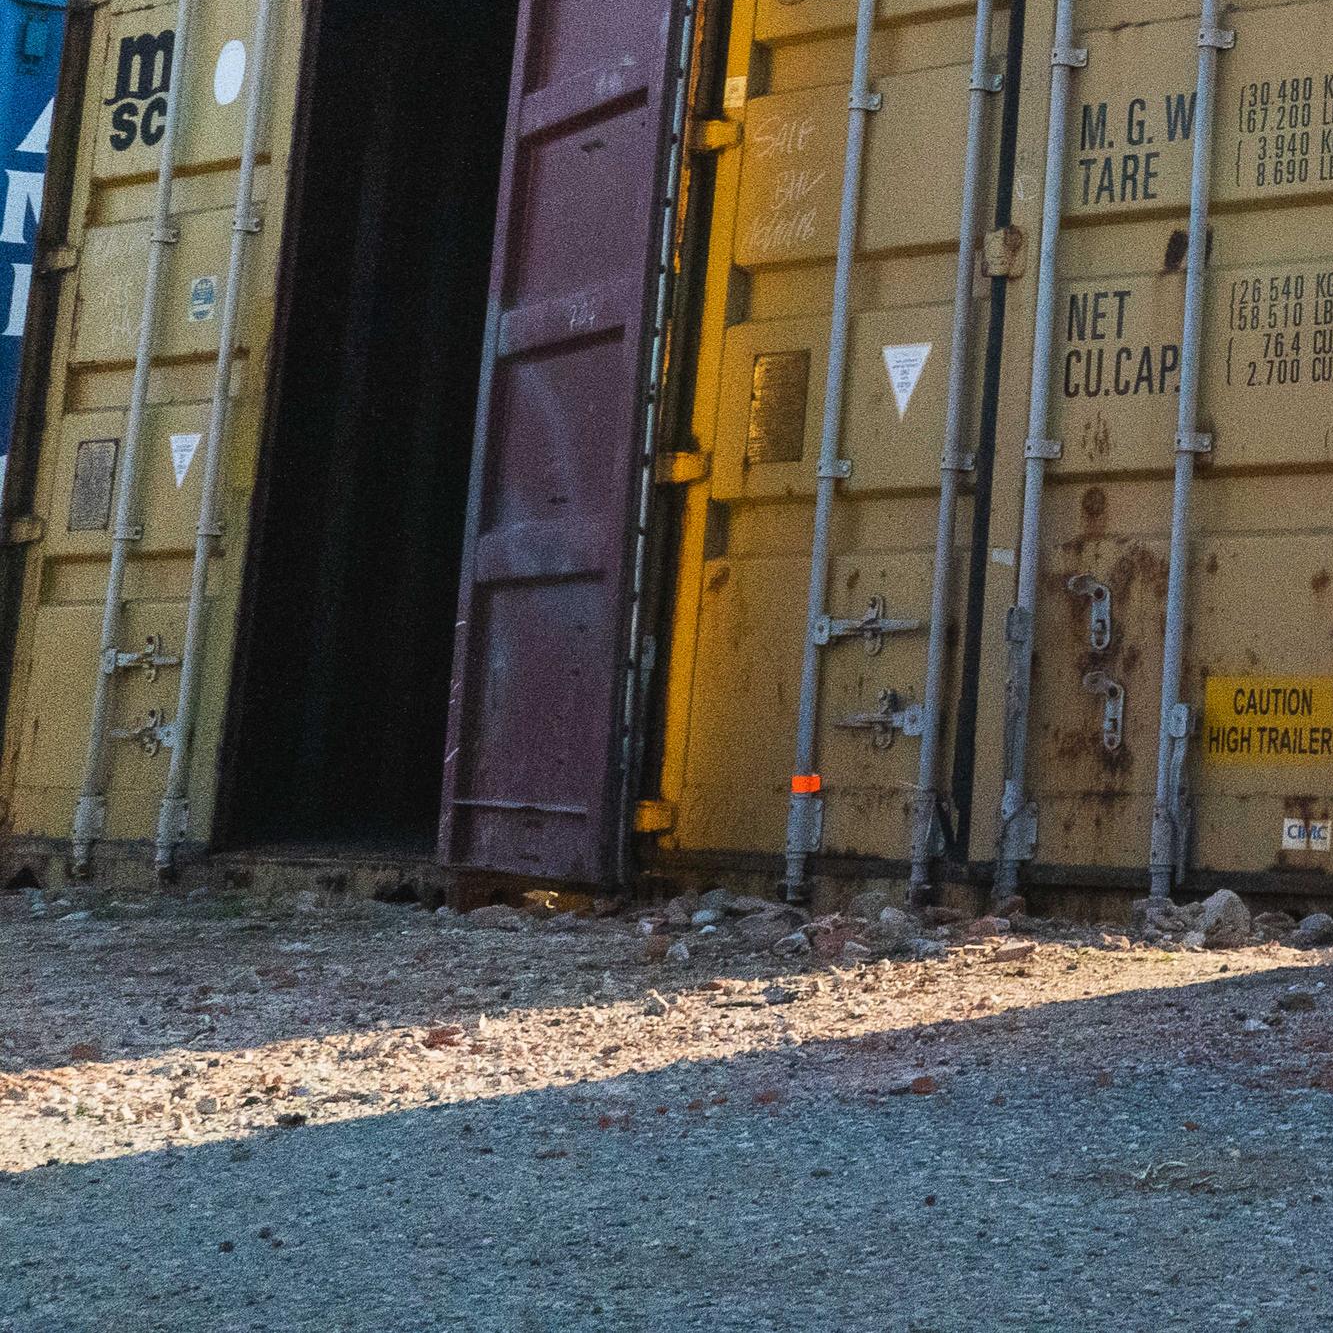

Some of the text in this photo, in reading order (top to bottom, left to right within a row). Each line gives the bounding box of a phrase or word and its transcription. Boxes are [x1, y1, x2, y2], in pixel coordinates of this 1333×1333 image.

[1078, 152, 1160, 206] TARE
[1067, 289, 1132, 342] NET
[1233, 687, 1313, 716] CAUTION
[1209, 725, 1332, 756] HIGH TRAILER
